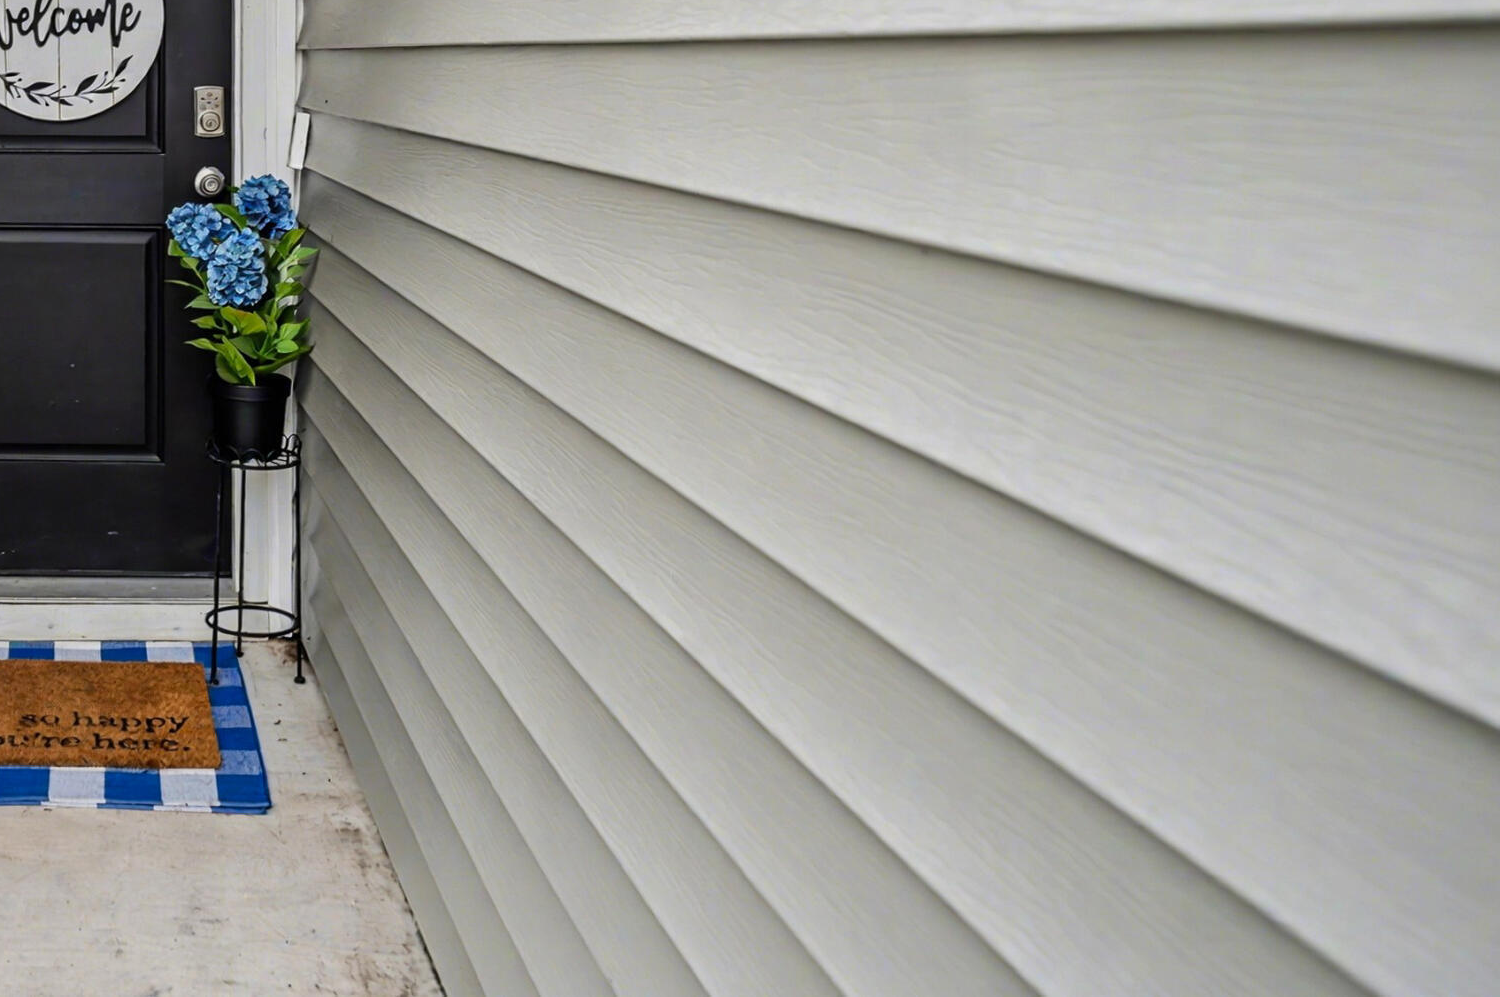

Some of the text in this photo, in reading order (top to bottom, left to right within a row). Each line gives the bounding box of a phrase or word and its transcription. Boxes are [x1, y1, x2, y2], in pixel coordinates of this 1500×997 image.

[19, 711, 190, 733] so happy
[92, 734, 190, 751] here.
